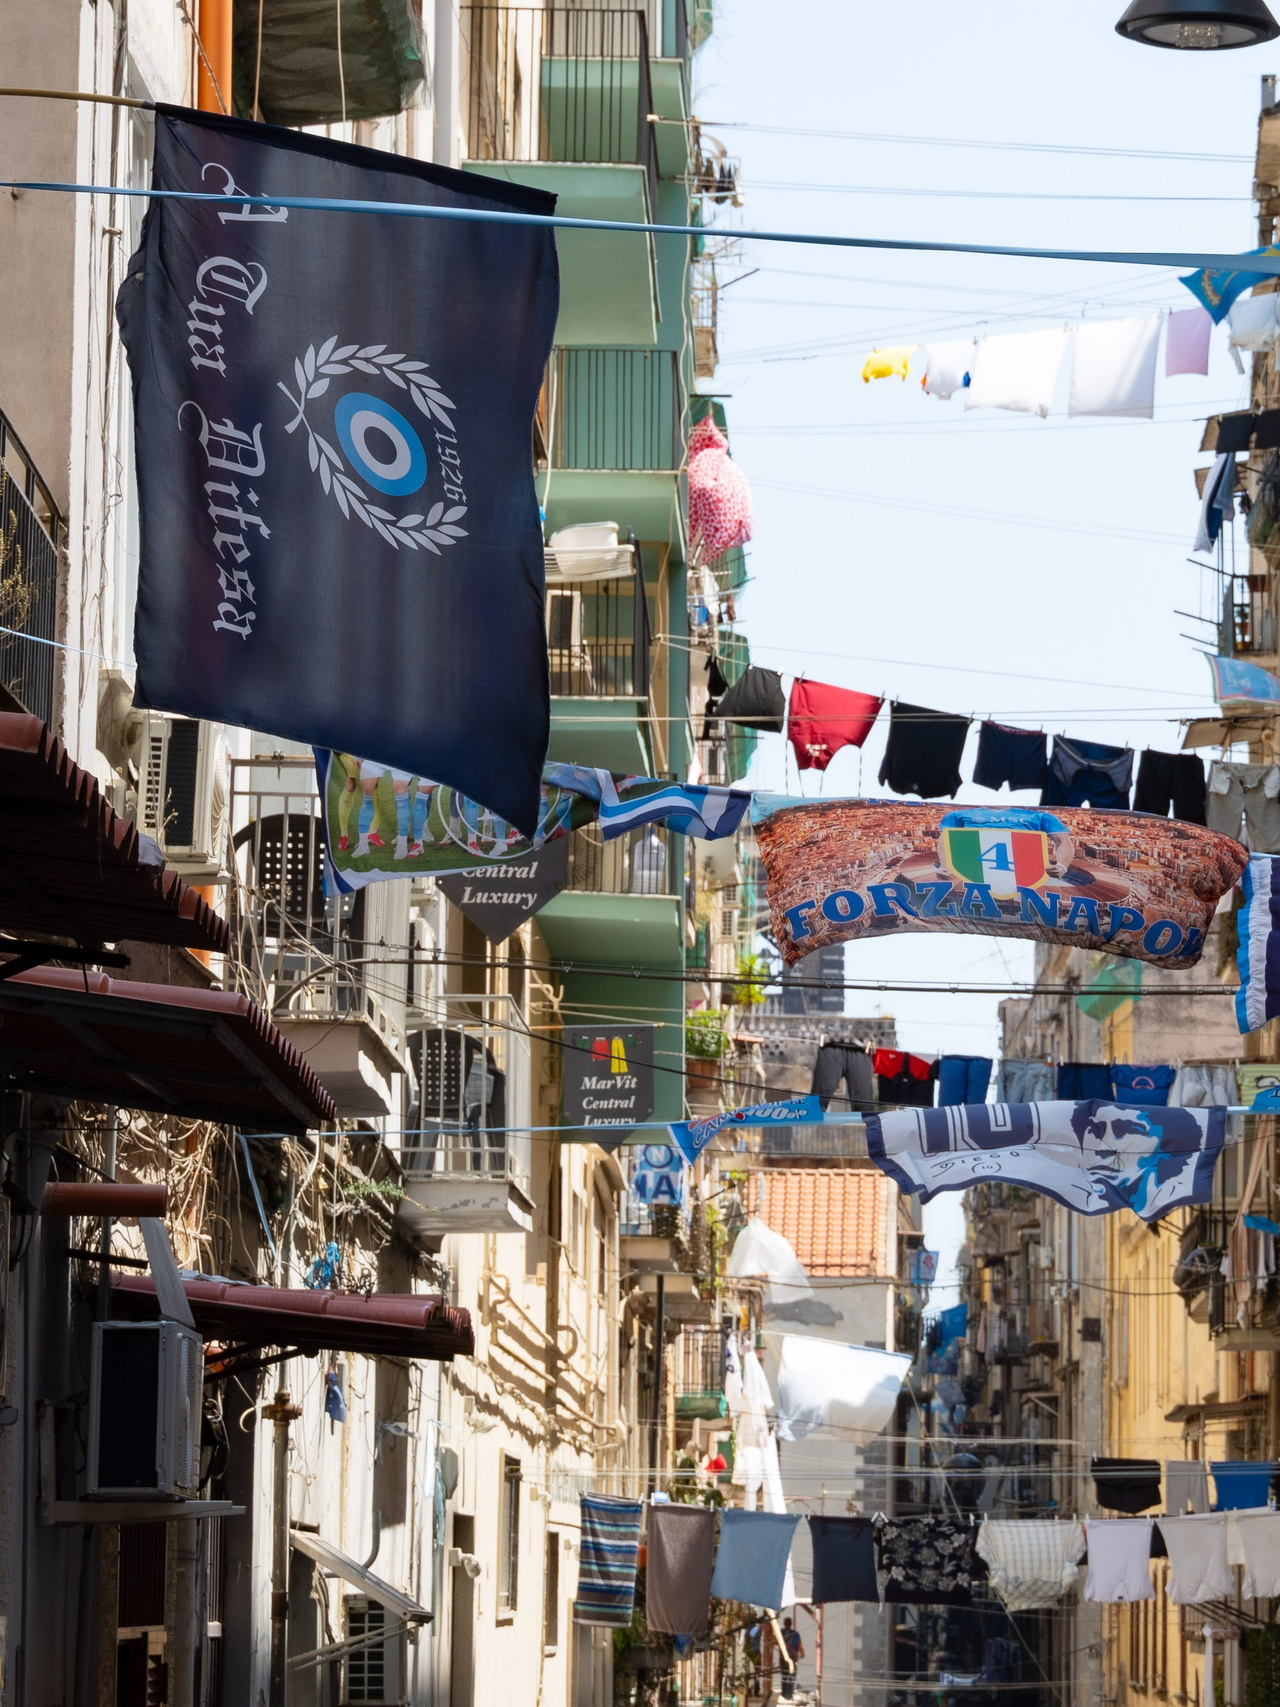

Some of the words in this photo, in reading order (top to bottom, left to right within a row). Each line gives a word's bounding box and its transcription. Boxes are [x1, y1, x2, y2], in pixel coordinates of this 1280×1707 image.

[200, 162, 288, 225] A
[186, 255, 269, 377] Tua
[437, 427, 468, 503] 1926
[177, 399, 271, 640] Difesa
[978, 842, 1015, 872] 4
[461, 886, 538, 910] Luxury
[784, 881, 1002, 942] FORZA
[580, 1075, 638, 1090] MarVit
[582, 1095, 636, 1110] Central
[652, 1147, 666, 1162] N
